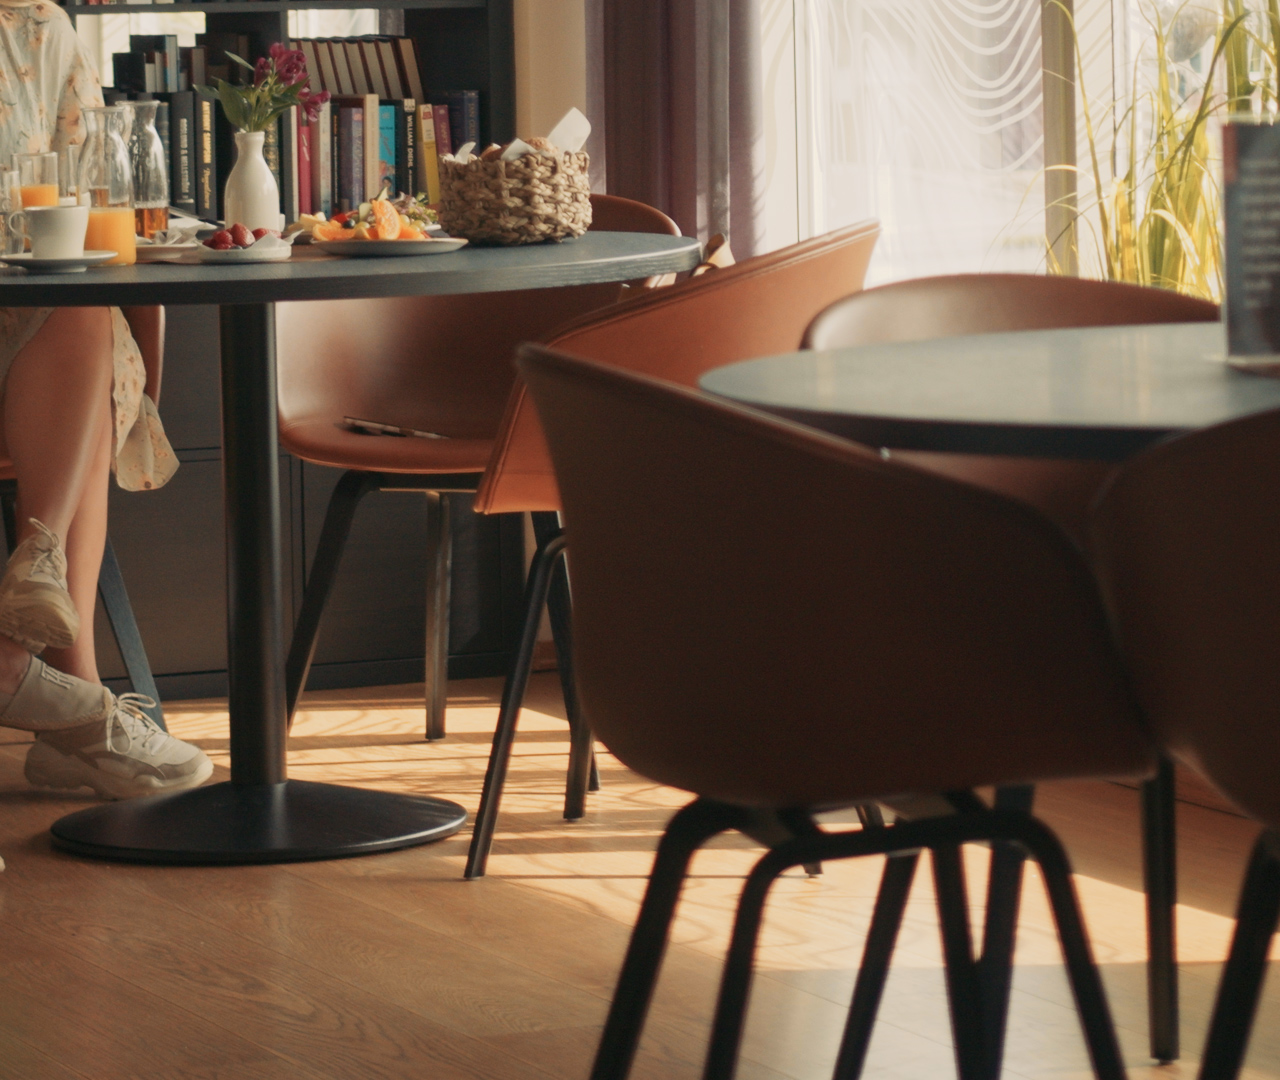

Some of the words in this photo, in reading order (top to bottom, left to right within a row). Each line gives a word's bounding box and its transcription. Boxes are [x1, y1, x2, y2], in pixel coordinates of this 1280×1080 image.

[202, 100, 211, 131] ANTHONY
[406, 115, 415, 147] WILLIAM
[202, 132, 212, 164] SAMPSON
[406, 148, 415, 169] DIEHL
